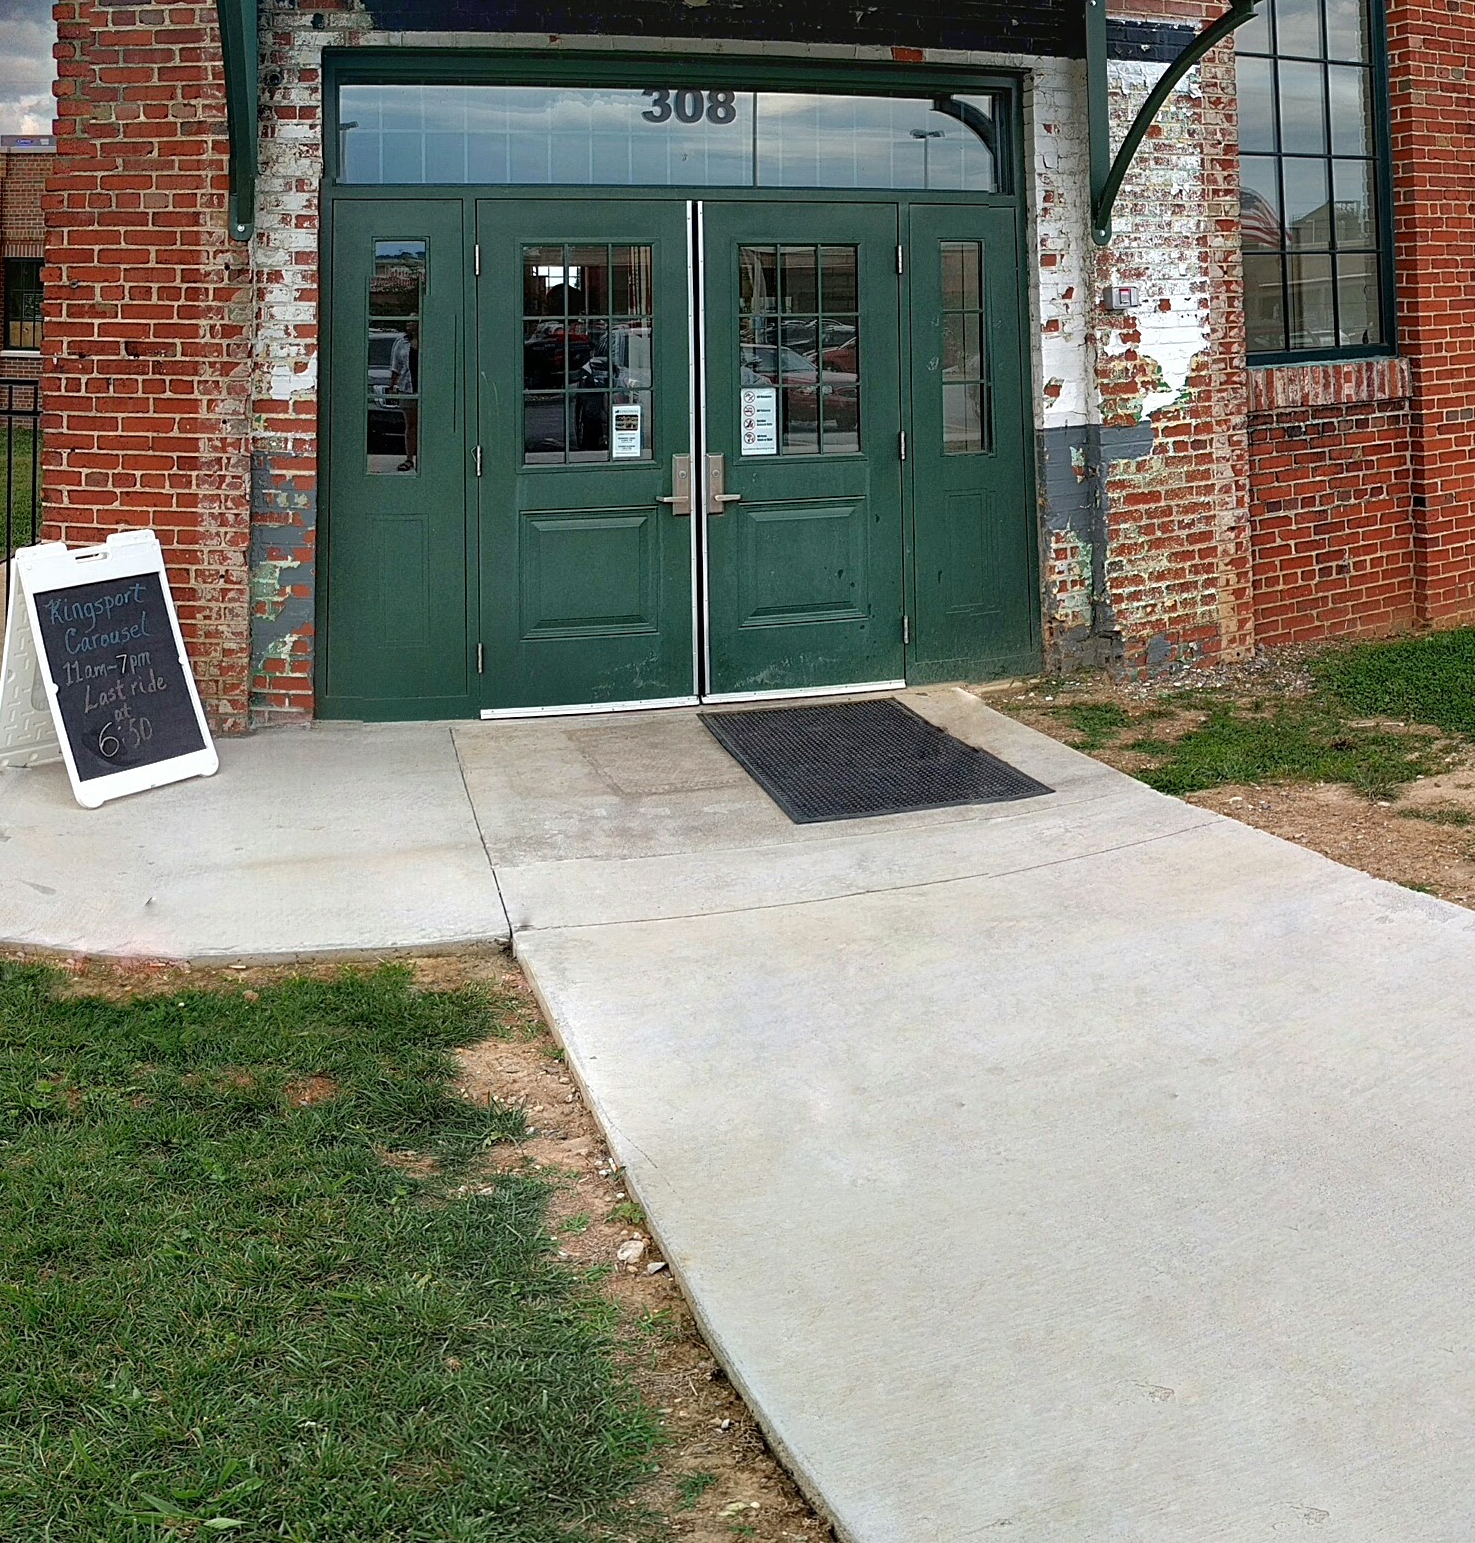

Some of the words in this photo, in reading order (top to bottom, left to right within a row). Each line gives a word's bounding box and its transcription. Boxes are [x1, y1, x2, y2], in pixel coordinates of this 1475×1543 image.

[640, 89, 737, 125] 308
[44, 583, 147, 634] Kingsport
[64, 610, 151, 655] Carousel
[84, 679, 126, 714] Last
[131, 668, 168, 696] ride
[114, 703, 132, 723] at
[98, 716, 153, 758] 6:50
